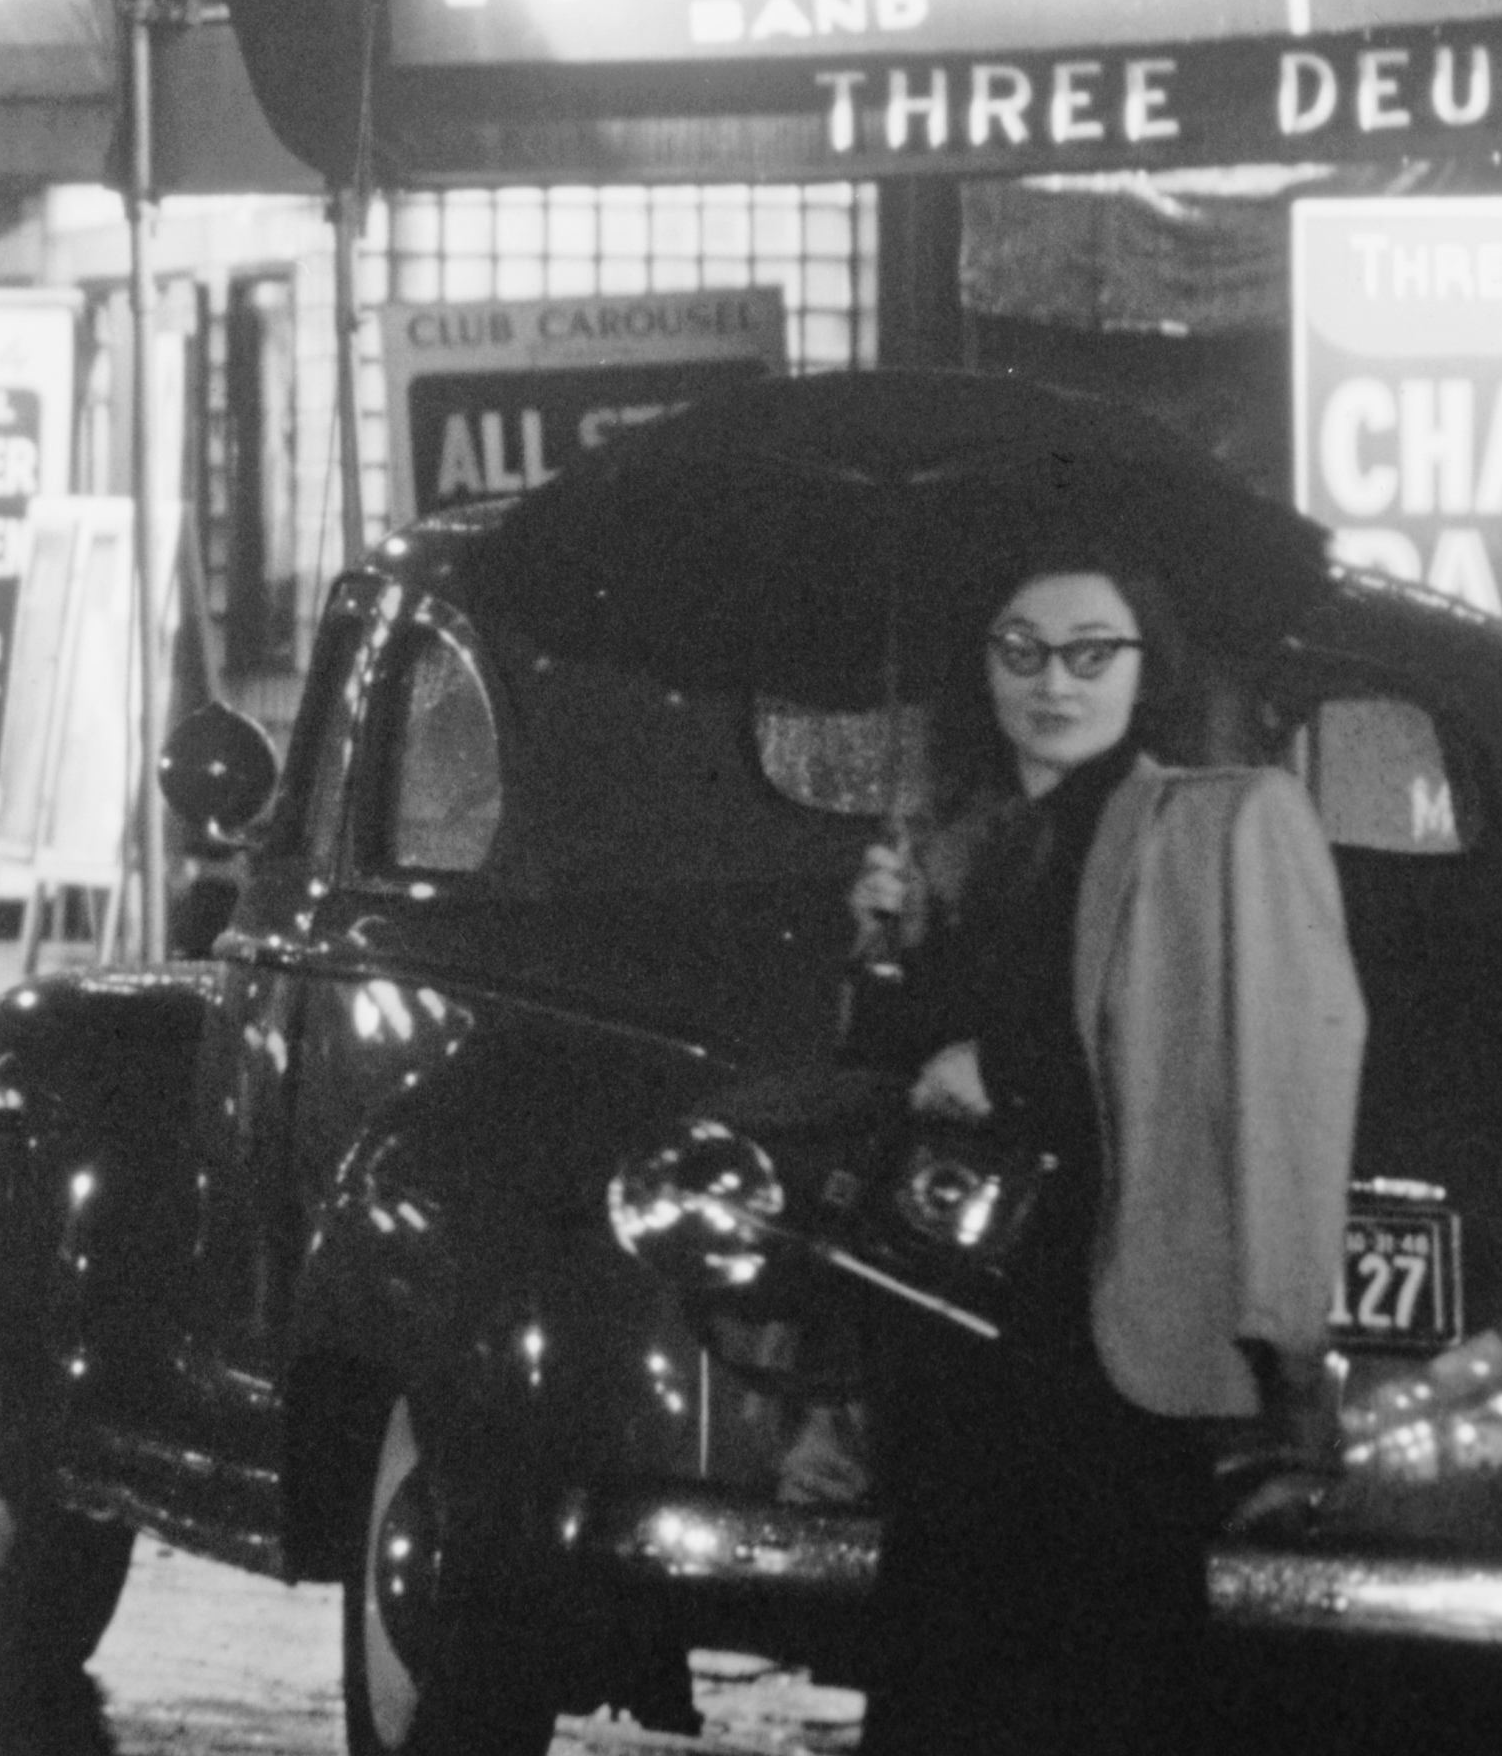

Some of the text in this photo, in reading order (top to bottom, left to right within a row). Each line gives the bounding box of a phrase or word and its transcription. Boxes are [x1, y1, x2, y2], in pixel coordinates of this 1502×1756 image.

[814, 58, 1181, 154] THREE
[406, 309, 512, 351] CLUB
[437, 406, 563, 496] ALL
